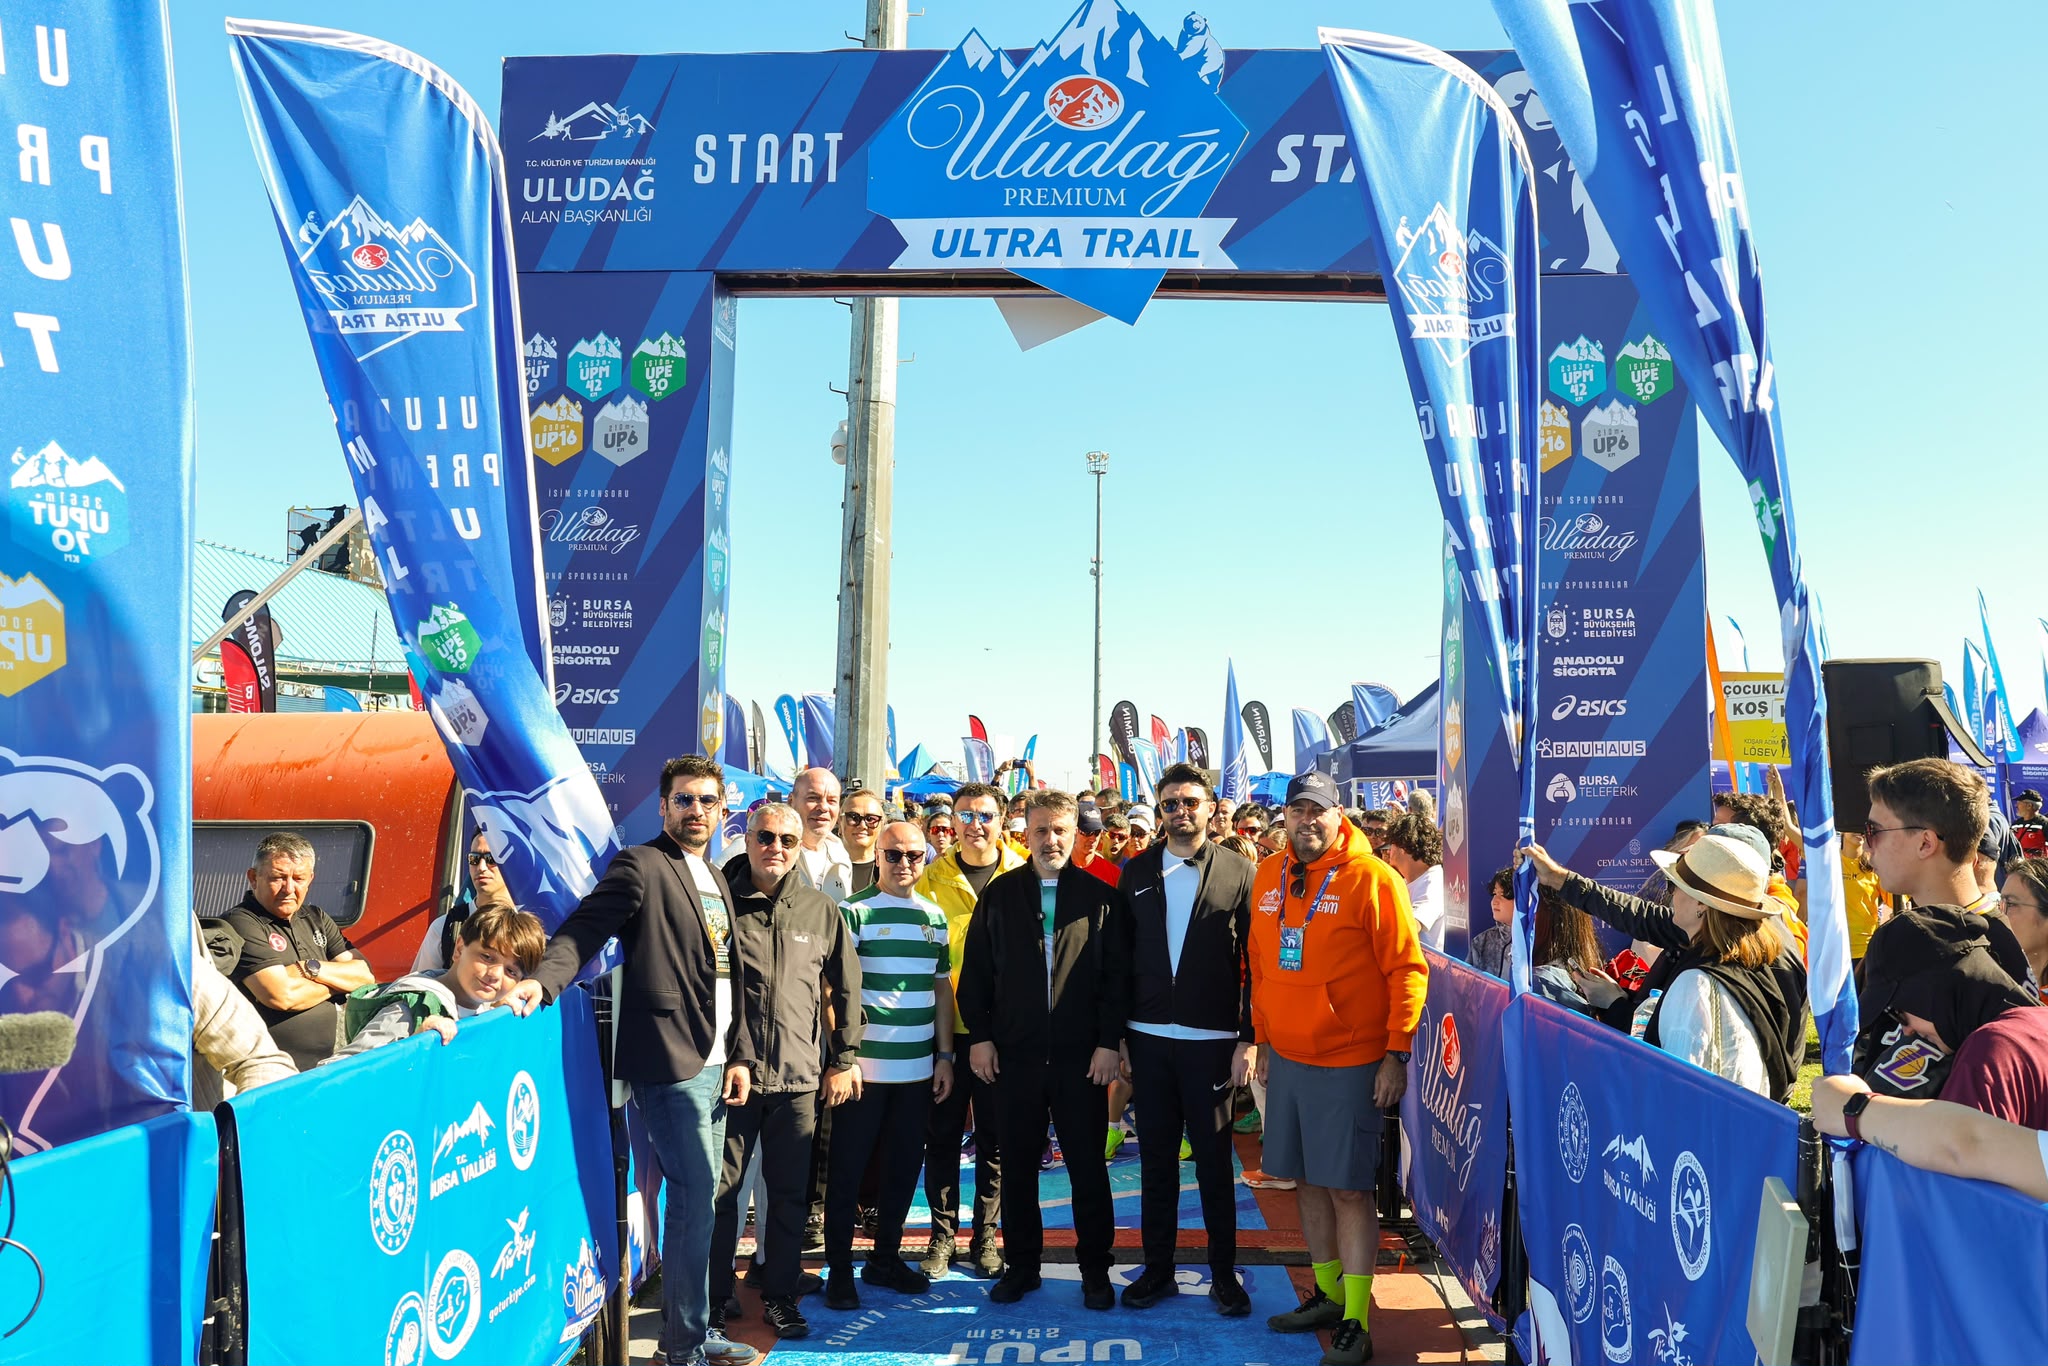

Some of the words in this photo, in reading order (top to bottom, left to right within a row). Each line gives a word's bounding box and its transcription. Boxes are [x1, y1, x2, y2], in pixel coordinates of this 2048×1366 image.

[541, 158, 571, 167] KÜLTÜR
[584, 157, 613, 166] TURİZM
[615, 157, 656, 166] BAKANLIĞI
[693, 132, 843, 184] START
[523, 169, 655, 202] ULUDAĞ
[1003, 187, 1127, 207] PREMIUM
[521, 209, 560, 224] ALAN
[564, 207, 652, 226] BAŞKANLIĞI
[931, 227, 1063, 259] ULTRA
[1082, 227, 1201, 259] TRAIL
[579, 365, 610, 381] UPM
[645, 365, 672, 380] UPE
[1562, 369, 1594, 385] UPM
[1630, 368, 1659, 384] UPE
[585, 379, 602, 393] 42
[649, 378, 668, 392] 30
[1569, 383, 1588, 397] 42
[1635, 382, 1656, 396] 30
[534, 430, 577, 449] UP16
[603, 430, 638, 449] UP6
[1593, 435, 1629, 454] UP6
[577, 489, 630, 498] SPONSORU
[1569, 495, 1624, 505] SPONSORU
[568, 572, 628, 581] SPONSORLAR
[1565, 580, 1629, 590] SPONSORLAR
[582, 600, 633, 611] BURSA
[582, 611, 633, 620] BÜYÜKŞEHİR
[1583, 608, 1635, 620] BURSA
[582, 620, 633, 628] BELEDİYESİ
[1583, 618, 1636, 629] BÜYÜKŞEHİR
[1584, 628, 1636, 638] BELEDİYESİ
[436, 632, 465, 659] UPE
[552, 645, 620, 655] ANADOLU
[447, 650, 467, 669] 30
[552, 655, 612, 666] SİGORTA
[1553, 655, 1624, 666] ANADOLU
[1553, 665, 1617, 677] SİGORTA
[1733, 701, 1768, 718] KOŞ
[570, 728, 636, 745] UHAUS
[1552, 740, 1647, 758] BAUHAUS
[1743, 746, 1778, 757] LÖSEV
[1579, 775, 1618, 786] BURSA
[1579, 786, 1638, 798] TELEFERİK
[1596, 859, 1628, 867] CEYLAN
